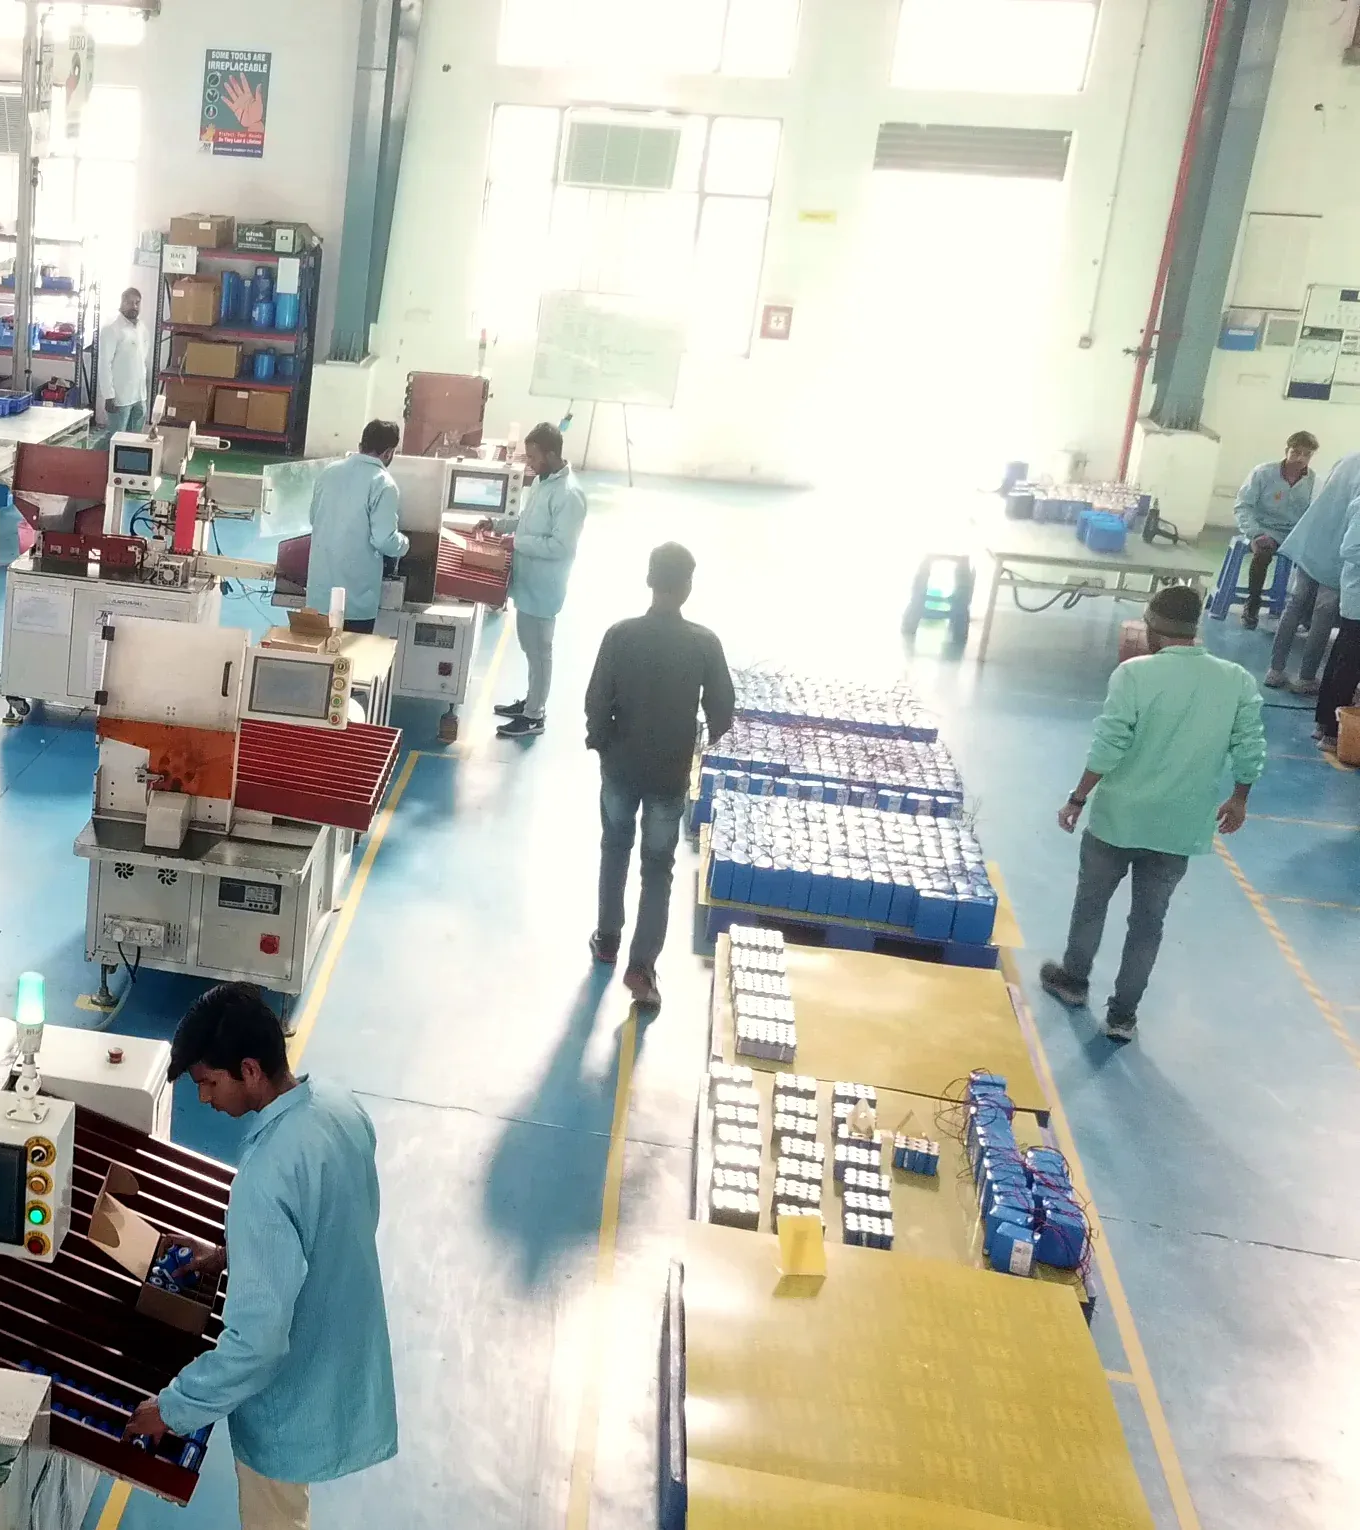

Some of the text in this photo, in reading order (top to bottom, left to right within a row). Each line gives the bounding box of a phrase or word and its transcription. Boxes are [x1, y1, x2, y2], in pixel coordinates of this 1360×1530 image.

[212, 51, 266, 61] SOME TOOLS ARE
[208, 61, 268, 73] IRREPLACEABLE
[170, 252, 187, 260] RACK
